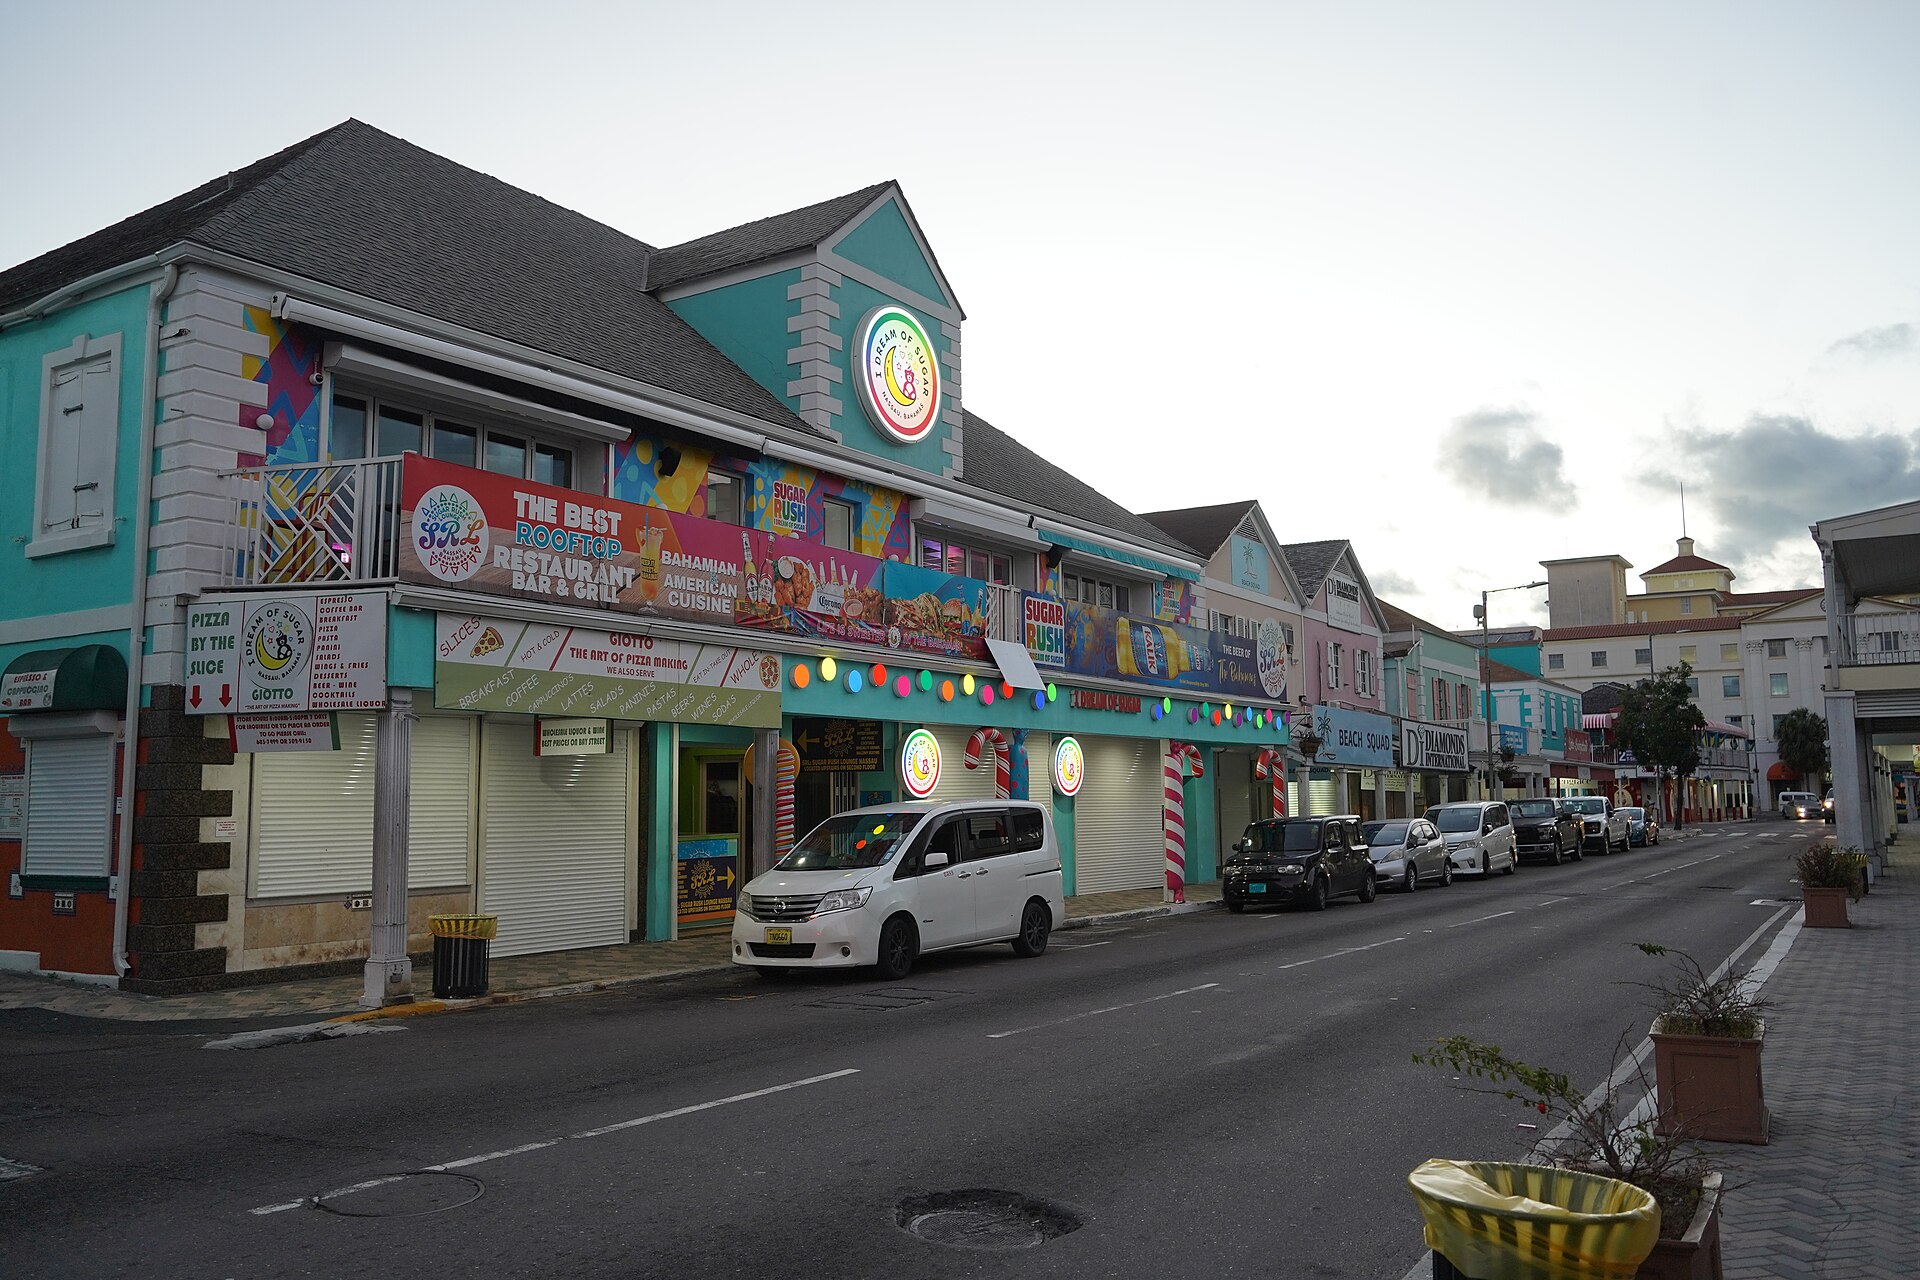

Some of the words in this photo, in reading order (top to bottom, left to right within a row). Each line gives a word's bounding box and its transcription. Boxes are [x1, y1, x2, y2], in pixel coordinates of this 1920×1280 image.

[876, 329, 896, 366] DREAM
[901, 331, 912, 343] OF
[914, 346, 929, 397] SUGAR
[904, 403, 924, 420] BAHAMAS
[774, 482, 805, 504] SUGAR
[432, 506, 449, 521] SUGAR
[452, 506, 466, 520] RUSH
[438, 512, 461, 521] LOUNGE
[514, 490, 558, 524] THE
[564, 502, 622, 536] BEST
[774, 499, 805, 523] RUSH
[419, 519, 484, 550] SRL
[516, 520, 622, 560] ROOFTOP
[439, 550, 466, 561] BAHAMAS
[494, 545, 636, 588] RESTAURANT
[662, 550, 737, 576] BAHAMIAN
[512, 571, 551, 594] BAR
[556, 578, 569, 596] &
[574, 582, 620, 604] GRILL
[664, 574, 738, 598] AMERICAN
[710, 571, 718, 584] &
[1251, 580, 1260, 590] SQUAD
[1336, 580, 1358, 597] DIAMONDS
[320, 596, 353, 604] ESPRESSO
[668, 591, 730, 614] CUISINE
[818, 595, 841, 610] Corona
[191, 612, 230, 628] PIZZA
[1026, 599, 1063, 626] SUGAR
[246, 616, 264, 656] DREAM
[266, 608, 279, 618] OF
[283, 610, 304, 644] SUGAR
[440, 615, 481, 657] SLICES
[610, 632, 653, 650] GIOTTO
[816, 620, 835, 634] LIFE
[837, 624, 845, 636] IS
[848, 626, 886, 642] SWEETER
[903, 633, 911, 644] IN
[913, 634, 926, 647] THE
[928, 636, 961, 651] BAHAMAS
[1026, 623, 1063, 654] RUSH
[191, 637, 207, 651] BY
[210, 636, 235, 650] THE
[521, 647, 536, 662] HOT
[542, 630, 560, 645] COLD
[1144, 630, 1156, 670] KALIK
[1223, 644, 1232, 655] THE
[1233, 646, 1244, 657] BEER
[1245, 649, 1251, 658] OF
[190, 660, 224, 675] SLICE
[258, 670, 280, 680] NASSAU,
[282, 652, 301, 678] BAHAMAS
[570, 648, 587, 659] THE
[590, 650, 608, 661] ART
[611, 653, 623, 663] OF
[626, 653, 652, 666] PIZZA
[654, 658, 688, 670] MAKING
[693, 673, 703, 683] EAT
[722, 649, 731, 660] OUT
[730, 650, 760, 684] WHOLE
[1051, 655, 1063, 664] SUGAR
[1260, 642, 1285, 673] SRL
[14, 674, 41, 683] ESPRESSO
[618, 667, 634, 676] ALSO
[636, 668, 655, 678] SERVE
[7, 685, 49, 695] CAPPUCCINO
[252, 688, 293, 700] GIOTTO
[458, 668, 516, 709] BREAKFAST
[506, 674, 540, 707] COFFEE
[528, 673, 575, 713] CAPPUCCINO'S
[560, 681, 594, 712] LATTES
[590, 685, 625, 714] SALAD'S
[619, 682, 657, 716] PANINI'S
[646, 687, 677, 717] PASTAS
[670, 692, 696, 718] BEER'S
[691, 692, 718, 721] WINE'S
[712, 694, 737, 722] SODA'S
[1074, 690, 1079, 707] I
[1081, 690, 1106, 710] DREAM
[1108, 693, 1118, 711] OF
[1119, 695, 1141, 713] SUGAR
[728, 705, 749, 725] WHOLESALE
[543, 728, 568, 736] WHOLESALE
[824, 727, 855, 748] SRL
[1339, 729, 1362, 748] BEACH
[1367, 733, 1390, 753] SQUAD
[1425, 730, 1465, 756] DIAMONDS
[1426, 752, 1466, 769] INTERNATIONAL
[691, 868, 716, 889] SRL
